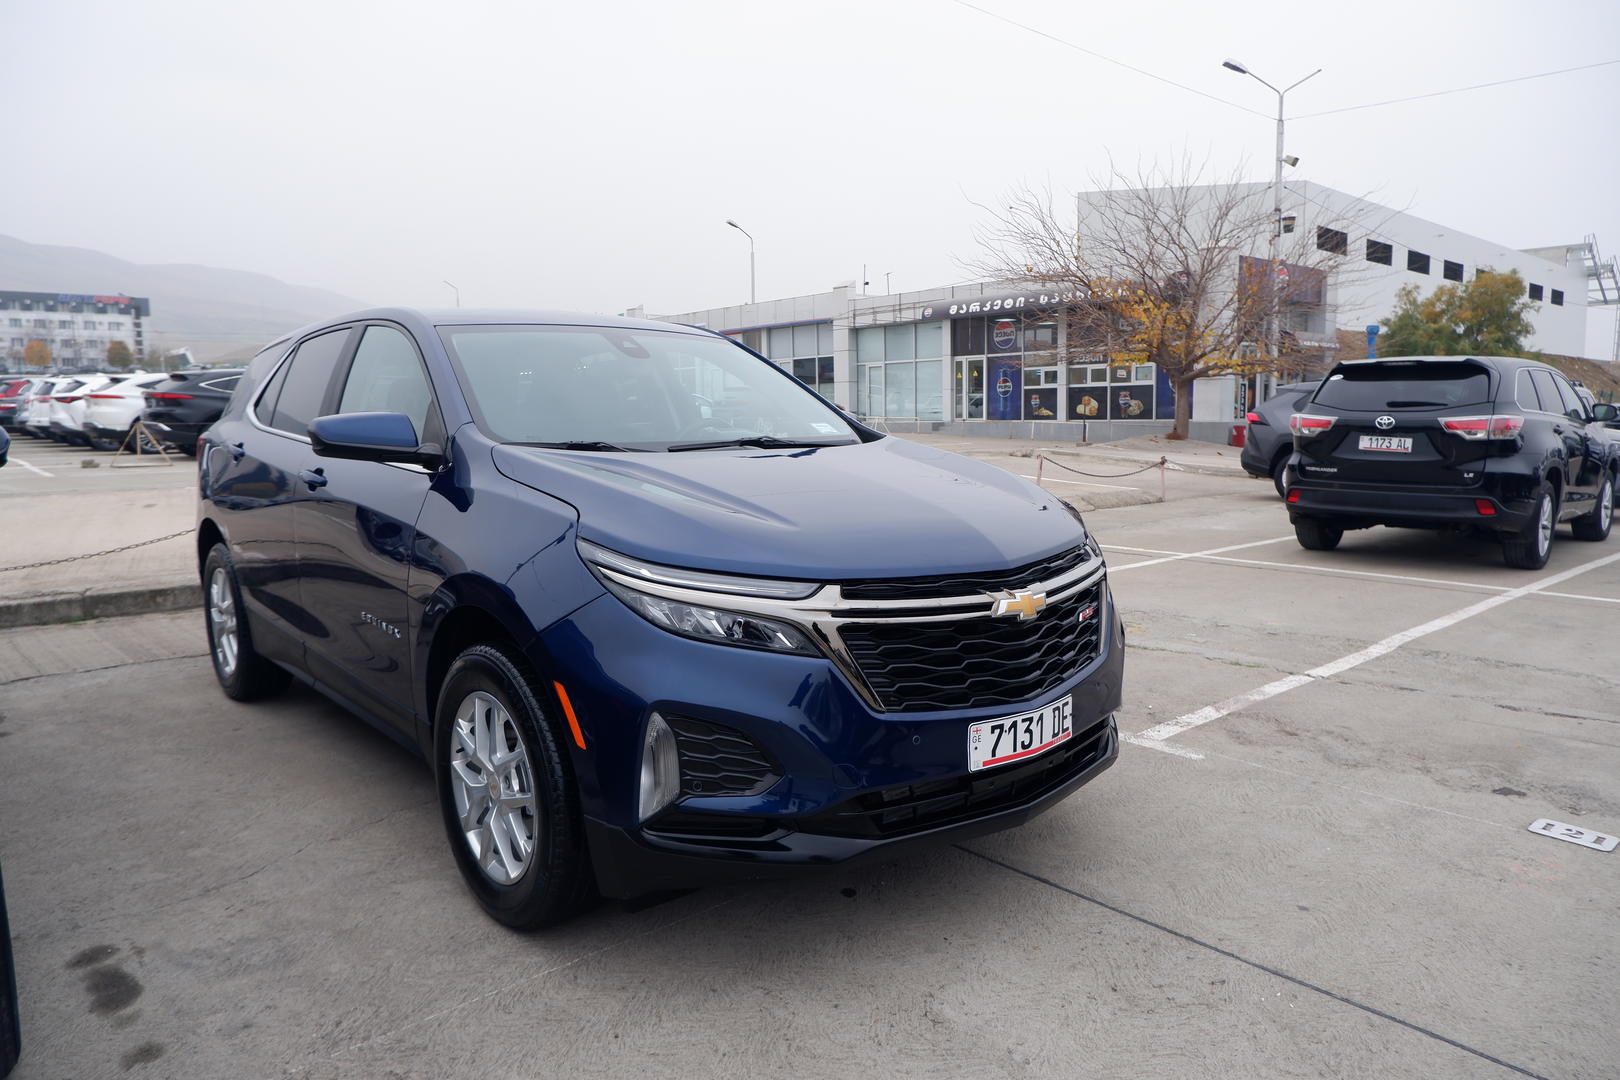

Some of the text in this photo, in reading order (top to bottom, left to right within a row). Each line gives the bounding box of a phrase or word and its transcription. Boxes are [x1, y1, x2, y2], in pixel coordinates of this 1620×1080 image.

[949, 296, 1025, 315] მარკეტი
[1368, 437, 1409, 450] 1173 AL
[990, 701, 1070, 758] 7131 DE
[972, 735, 982, 743] GE
